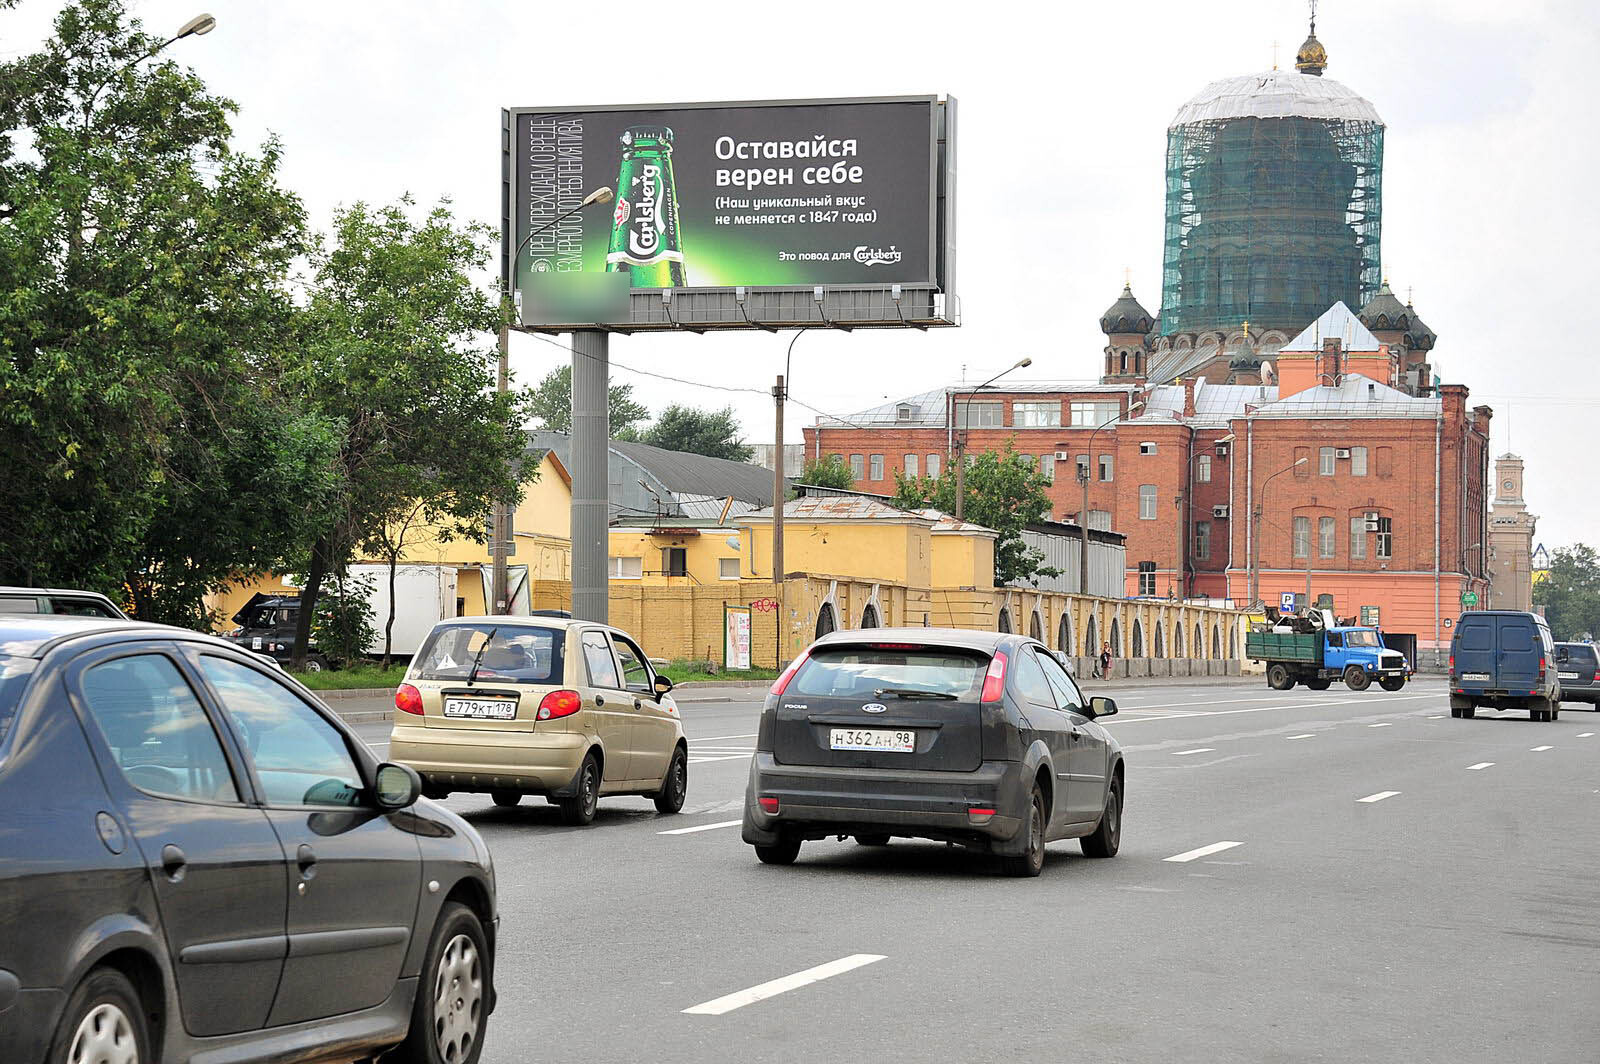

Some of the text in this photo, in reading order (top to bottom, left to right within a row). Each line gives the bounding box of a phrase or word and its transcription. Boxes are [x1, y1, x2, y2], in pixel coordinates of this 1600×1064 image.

[530, 119, 557, 152] ВРЕДЕ
[558, 119, 583, 146] ПИВА
[714, 134, 857, 160] Оставайся
[716, 161, 863, 191] верен себе
[530, 164, 557, 257] ПРЕДУПРЕЖДАЕМ
[629, 164, 662, 256] Carlsberg
[666, 187, 675, 235] COPENHAGEN
[715, 195, 866, 211] (Наш уникальный вкус
[715, 209, 877, 225] не меняется с 1847 года)
[557, 215, 583, 272] ЕЗМЕРНОГО
[779, 246, 902, 266] Это повод для Carlsberg
[1284, 595, 1292, 603] P
